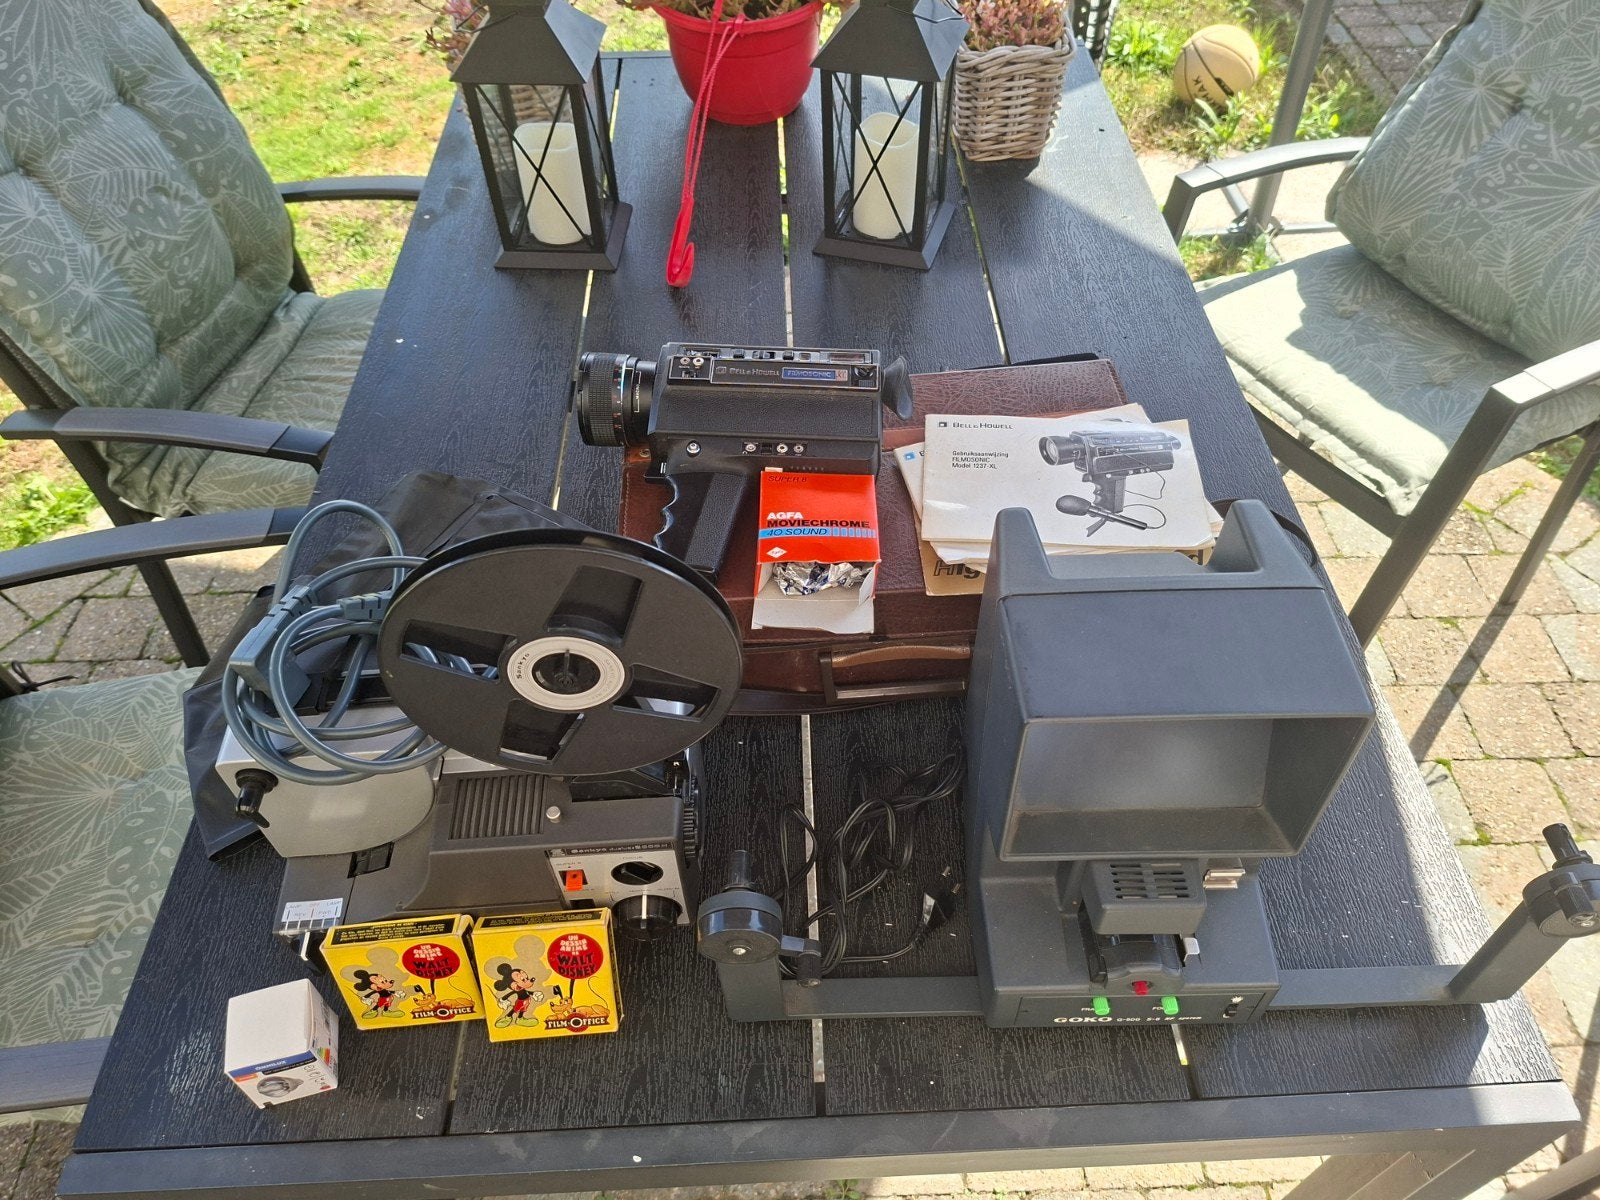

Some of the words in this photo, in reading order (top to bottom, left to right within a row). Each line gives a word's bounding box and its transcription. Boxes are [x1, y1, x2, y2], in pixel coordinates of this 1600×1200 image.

[952, 450, 1009, 458] Gebruiksaanwijzing
[768, 475, 801, 483] SUPER
[767, 512, 804, 520] AGFA
[767, 519, 871, 529] MOVIECHROME
[766, 529, 783, 537] 40
[785, 528, 828, 536] SOUND
[516, 653, 530, 680] Sankyo
[412, 957, 450, 969] WALT
[556, 952, 594, 966] WALT
[415, 966, 454, 977] DISNEY
[557, 963, 595, 977] DISNEY
